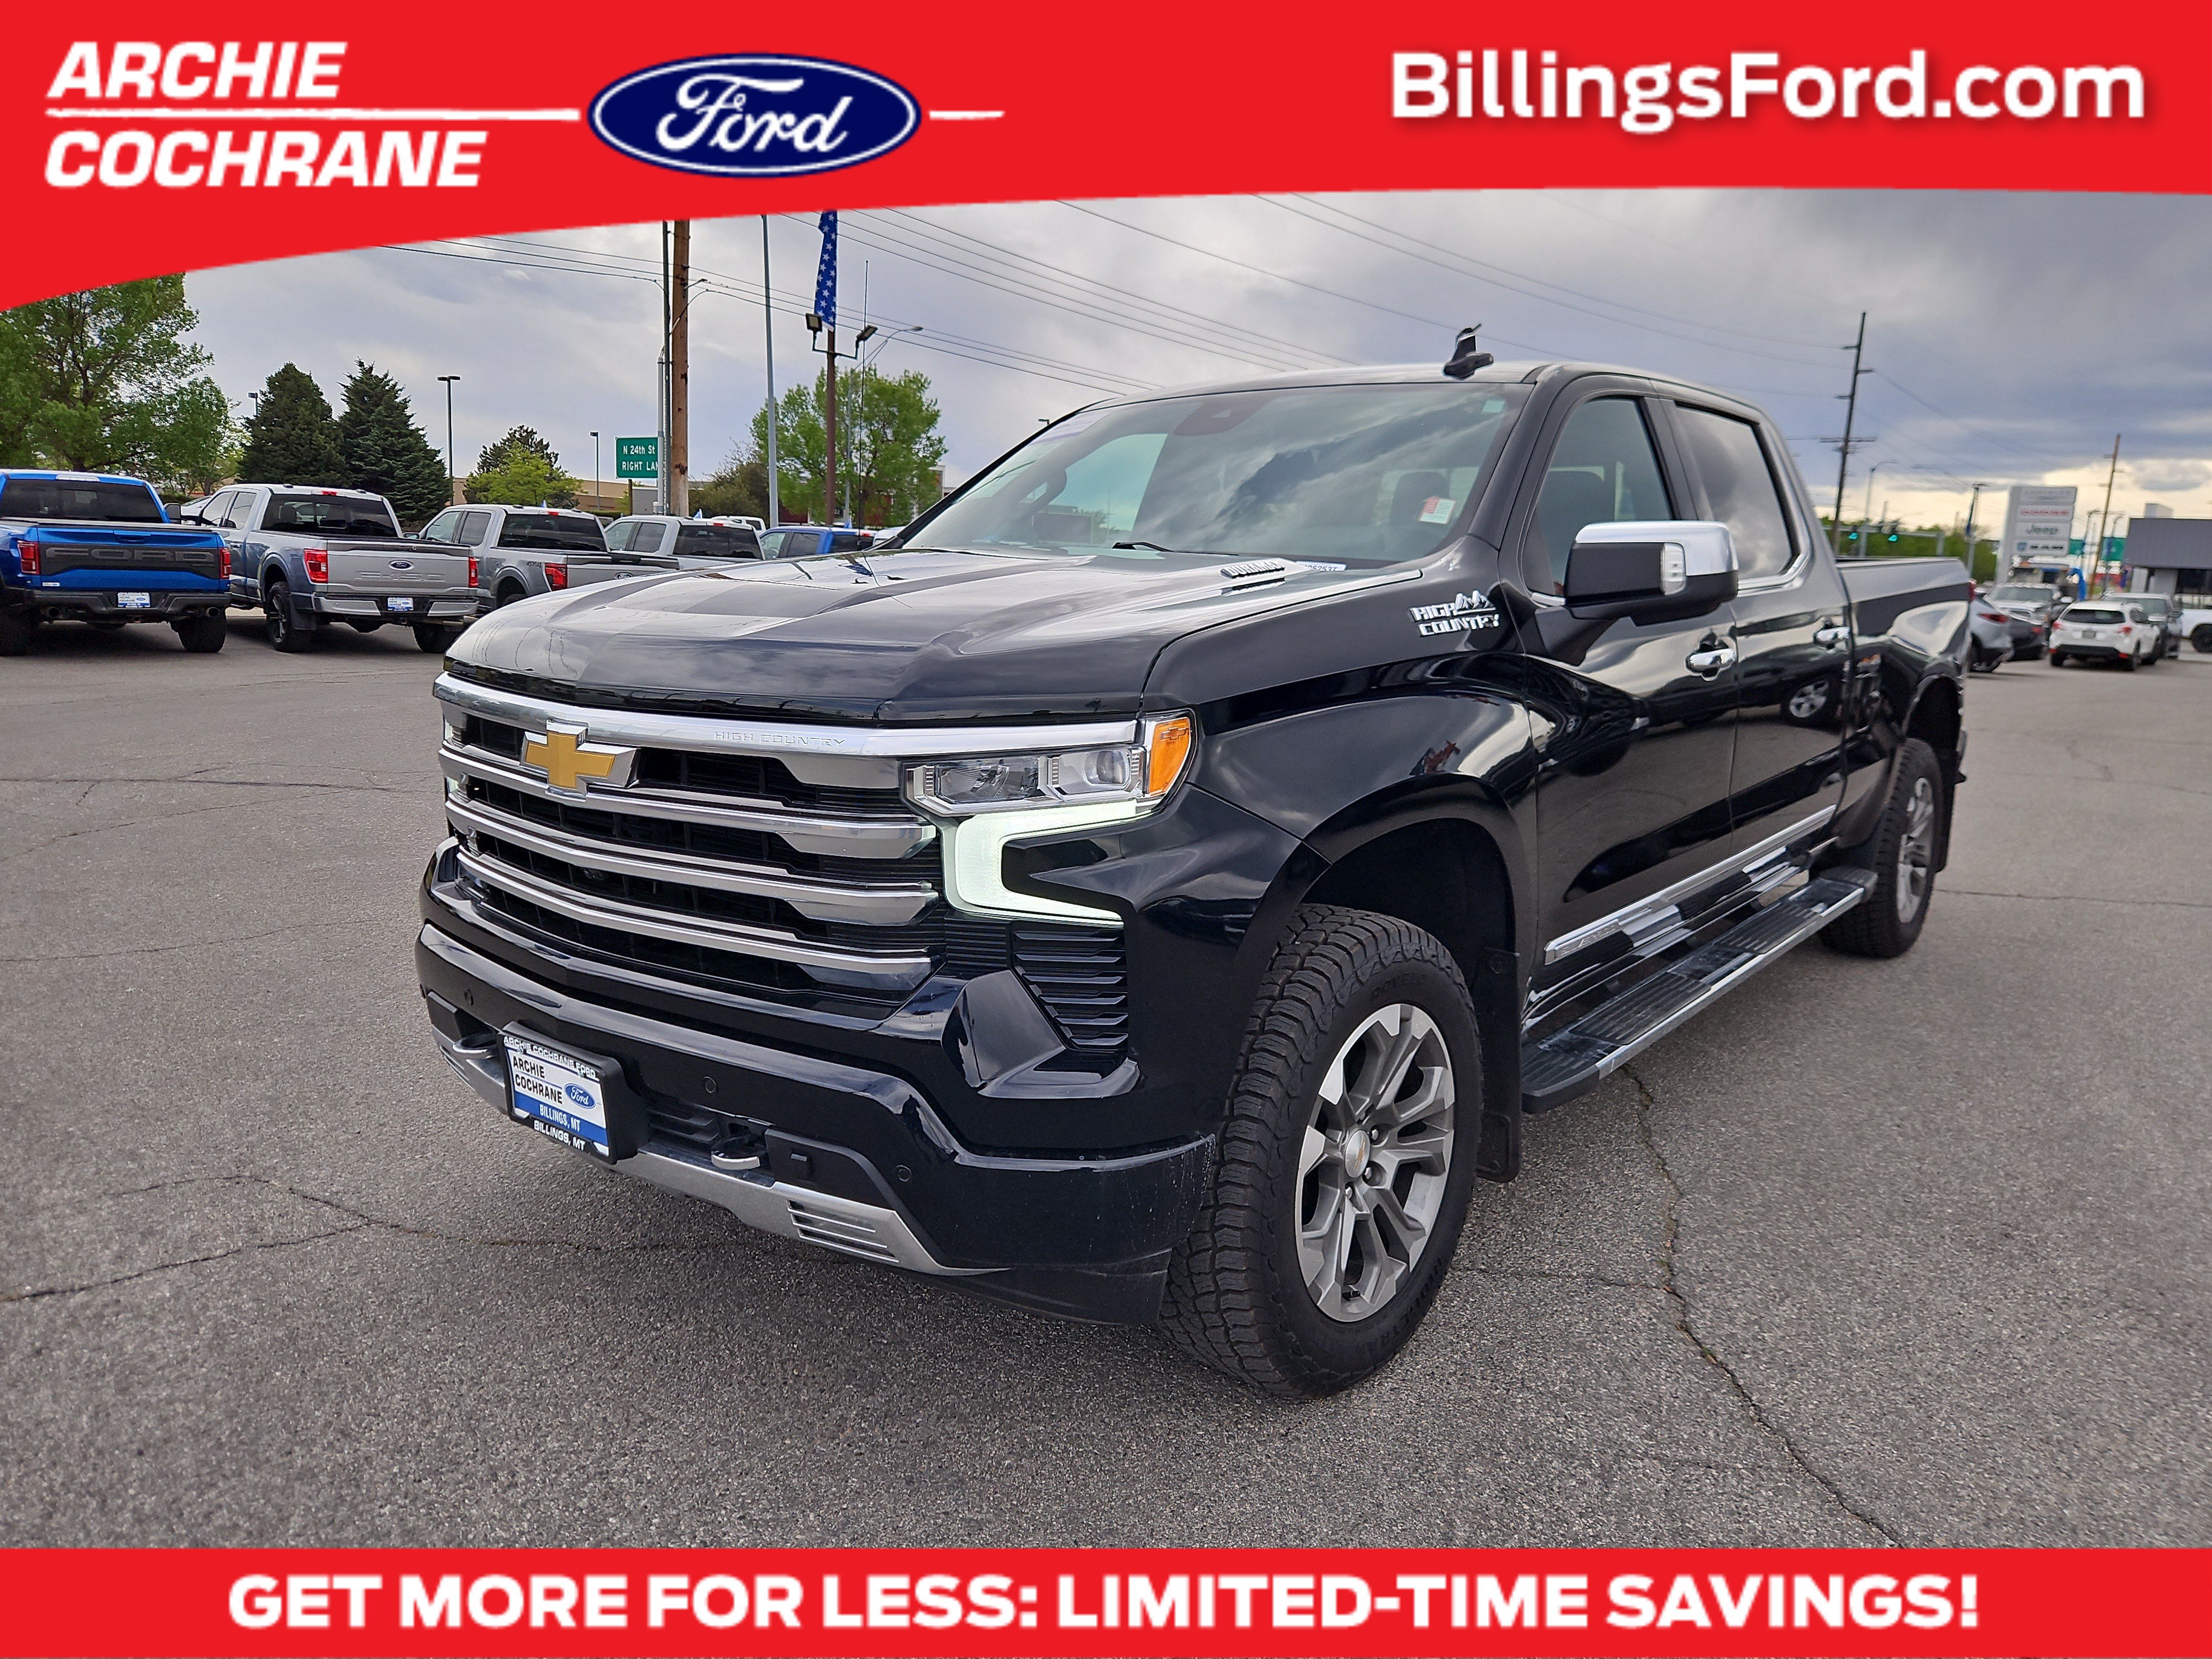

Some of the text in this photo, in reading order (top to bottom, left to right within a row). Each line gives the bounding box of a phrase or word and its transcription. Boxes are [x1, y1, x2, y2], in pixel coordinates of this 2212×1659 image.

[623, 445, 655, 454] N 24th St
[622, 461, 658, 471] RIGHT LAN
[46, 548, 214, 563] FORD
[1223, 561, 1285, 578] DURAMAX
[1410, 602, 1458, 621] HIGH
[1418, 614, 1500, 636] COUNTRY
[715, 731, 846, 747] HIGH COUNTRY
[503, 1036, 596, 1078] ARCHIE COCHRANE FORD
[513, 1056, 545, 1079] ARCHIE
[515, 1074, 563, 1104] COCHRANE
[570, 1086, 589, 1105] Ford
[539, 1104, 580, 1132] BILLINGS, MT
[533, 1120, 586, 1151] BILLINGS, MT
